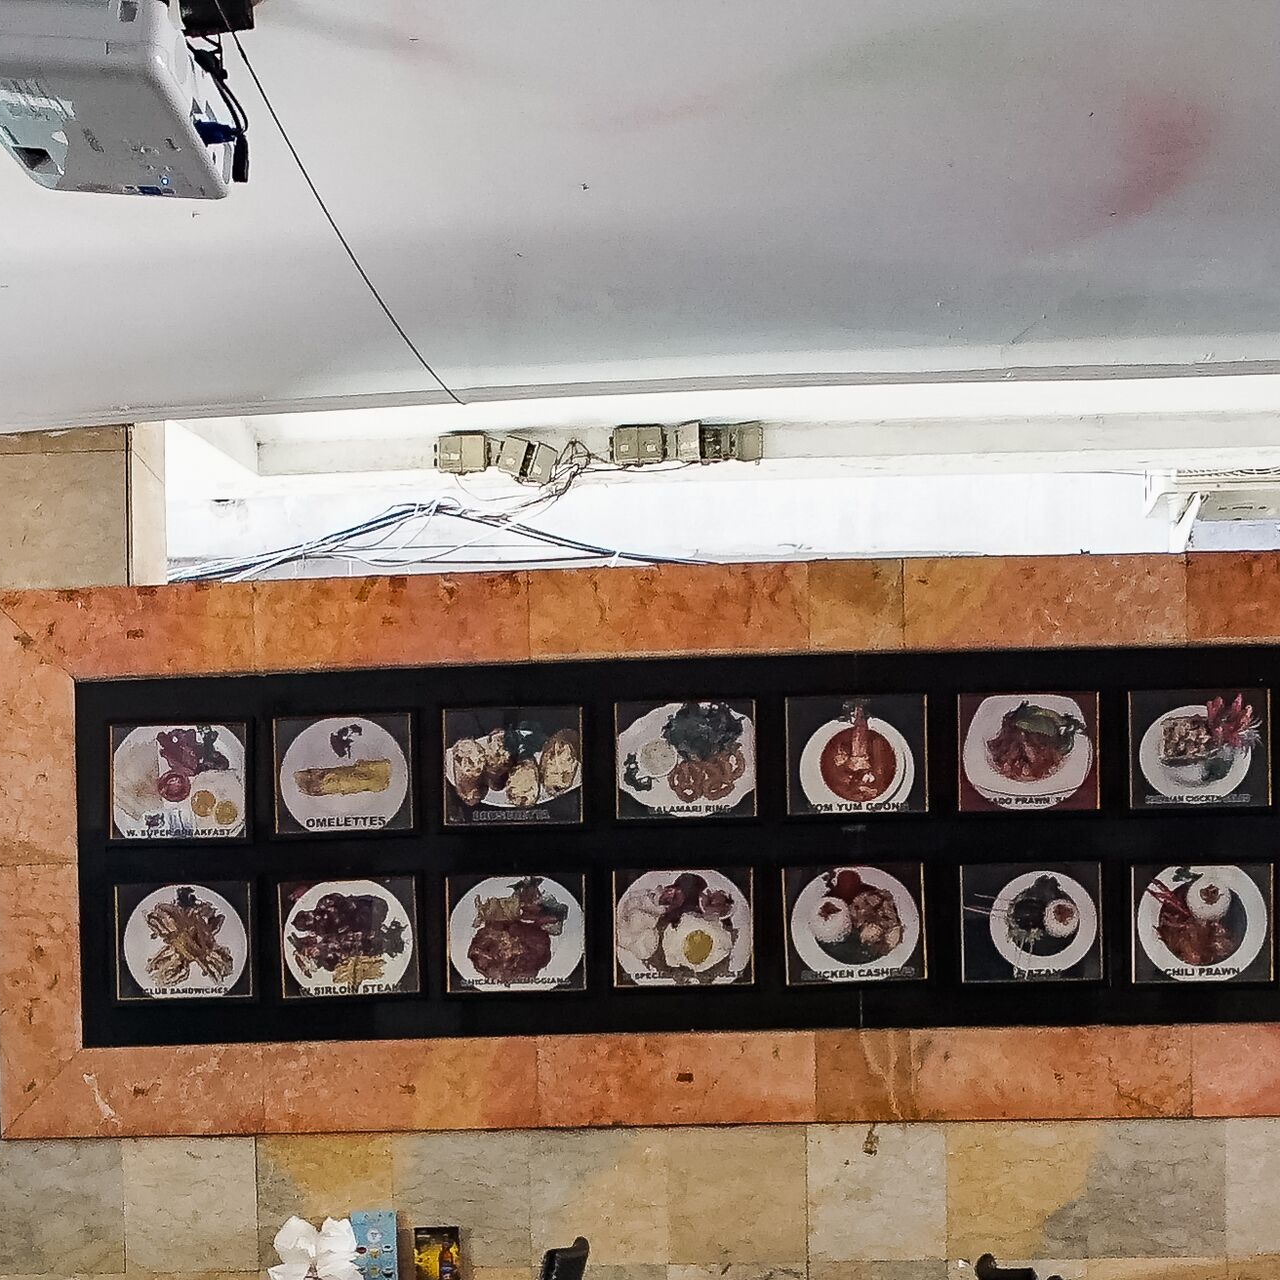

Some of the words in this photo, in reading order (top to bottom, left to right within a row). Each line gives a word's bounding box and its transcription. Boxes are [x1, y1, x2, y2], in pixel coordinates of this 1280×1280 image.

[1014, 797, 1051, 805] PRAWN
[833, 803, 858, 812] YUM
[305, 816, 386, 828] OMELETTES
[176, 828, 231, 838] EAKFAST
[801, 970, 854, 980] ICKEN
[1164, 967, 1195, 977] CHILI
[1198, 967, 1241, 977] PRAWN
[143, 987, 168, 995] CLUB
[313, 984, 359, 995] SIRLOIN
